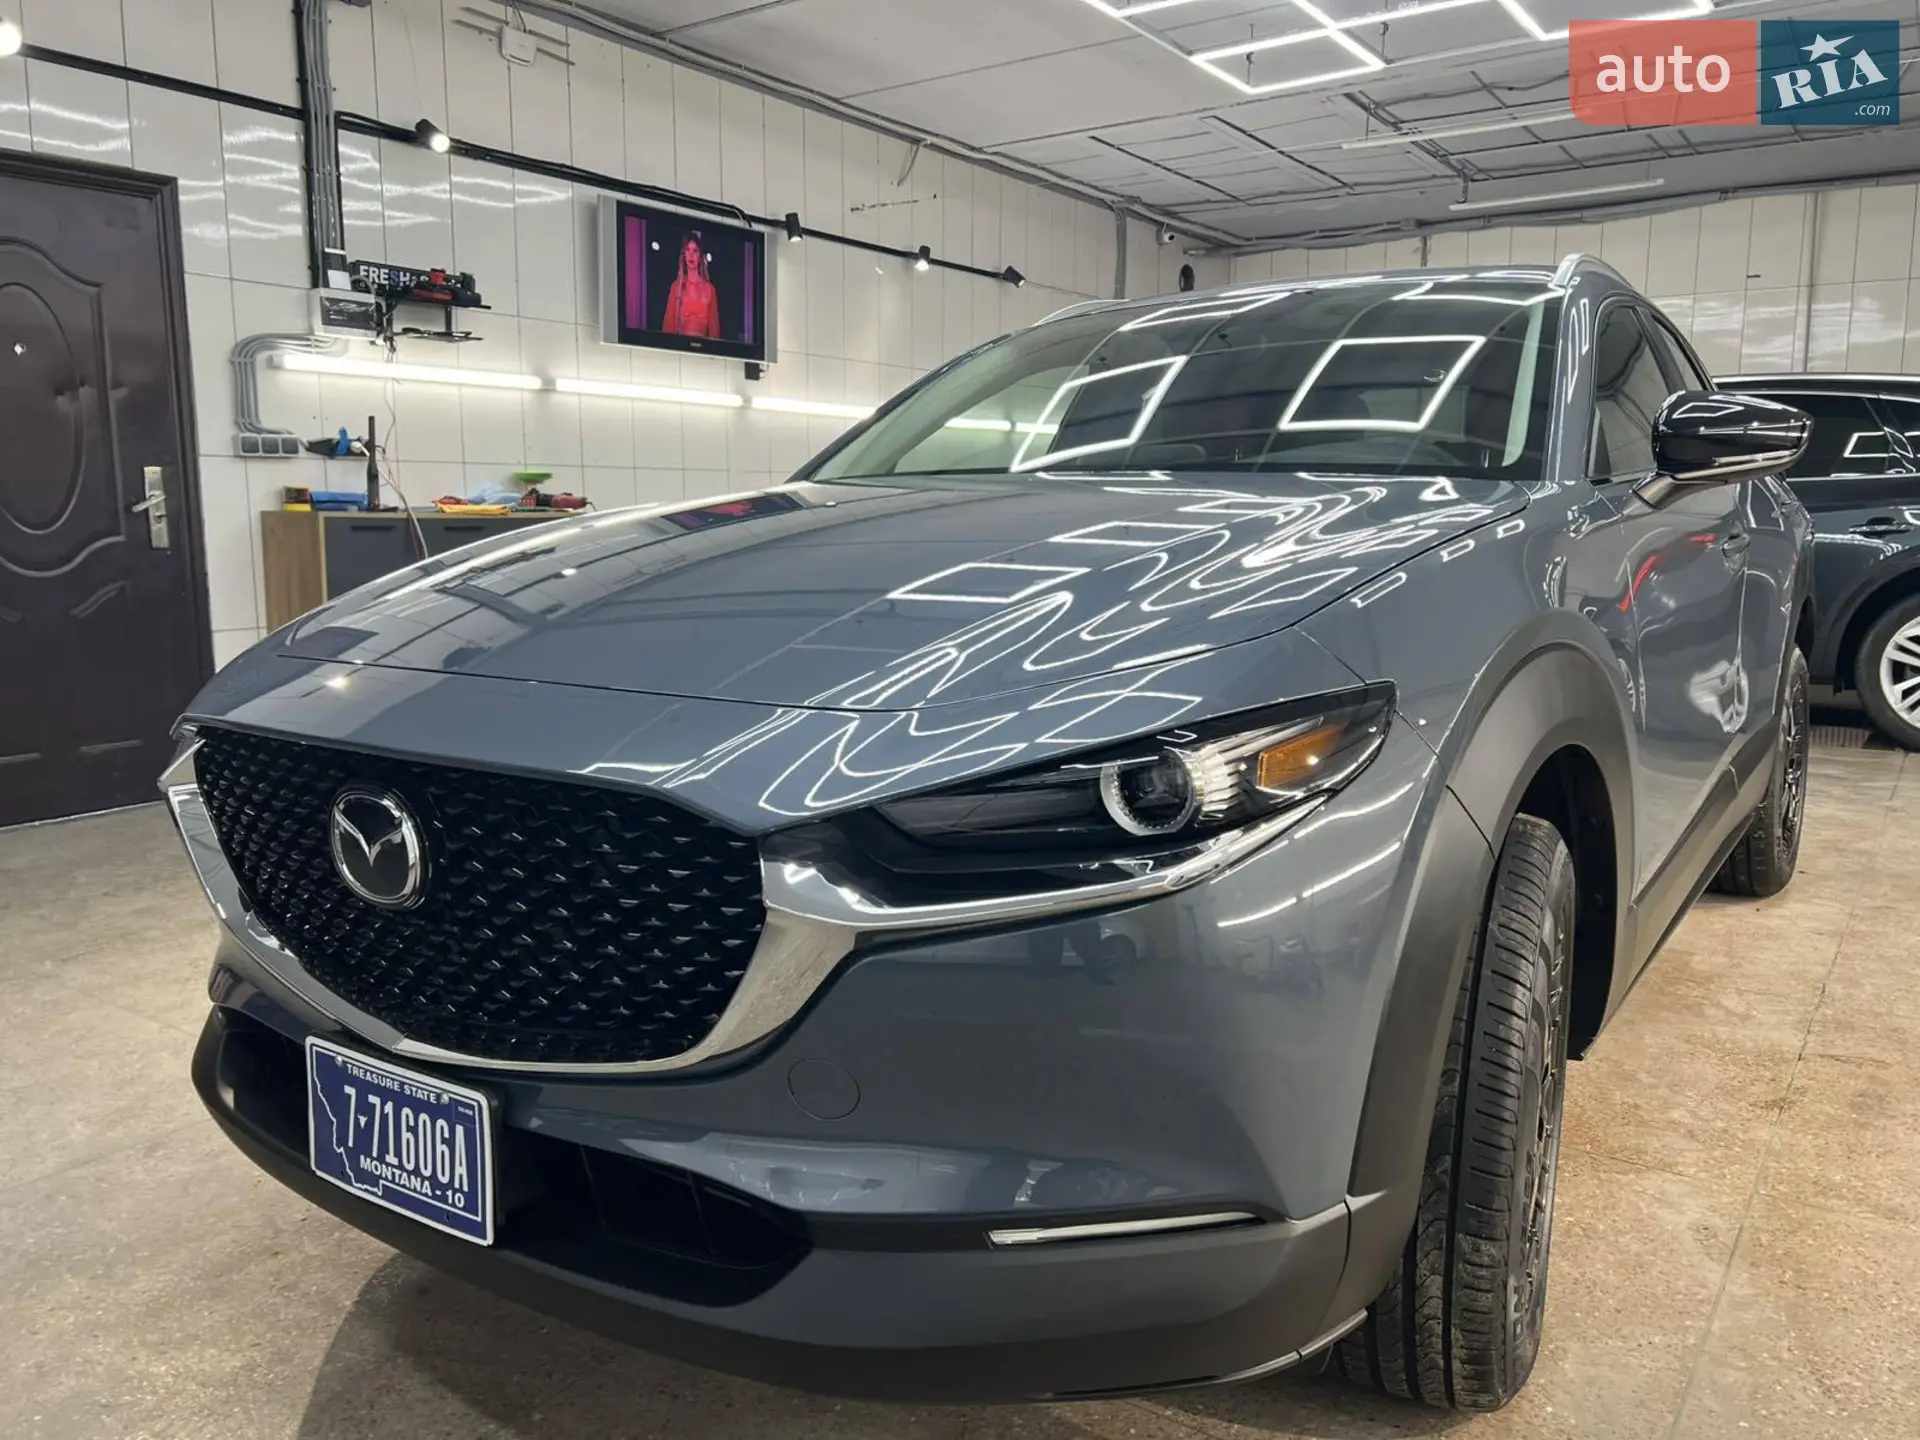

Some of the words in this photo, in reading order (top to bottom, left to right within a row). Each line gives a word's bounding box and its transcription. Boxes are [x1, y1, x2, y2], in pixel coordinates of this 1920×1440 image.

[346, 1064, 401, 1092] TREASURE
[403, 1084, 437, 1104] STATE
[367, 1094, 468, 1192] 71606A
[359, 1154, 432, 1196] MONTANA
